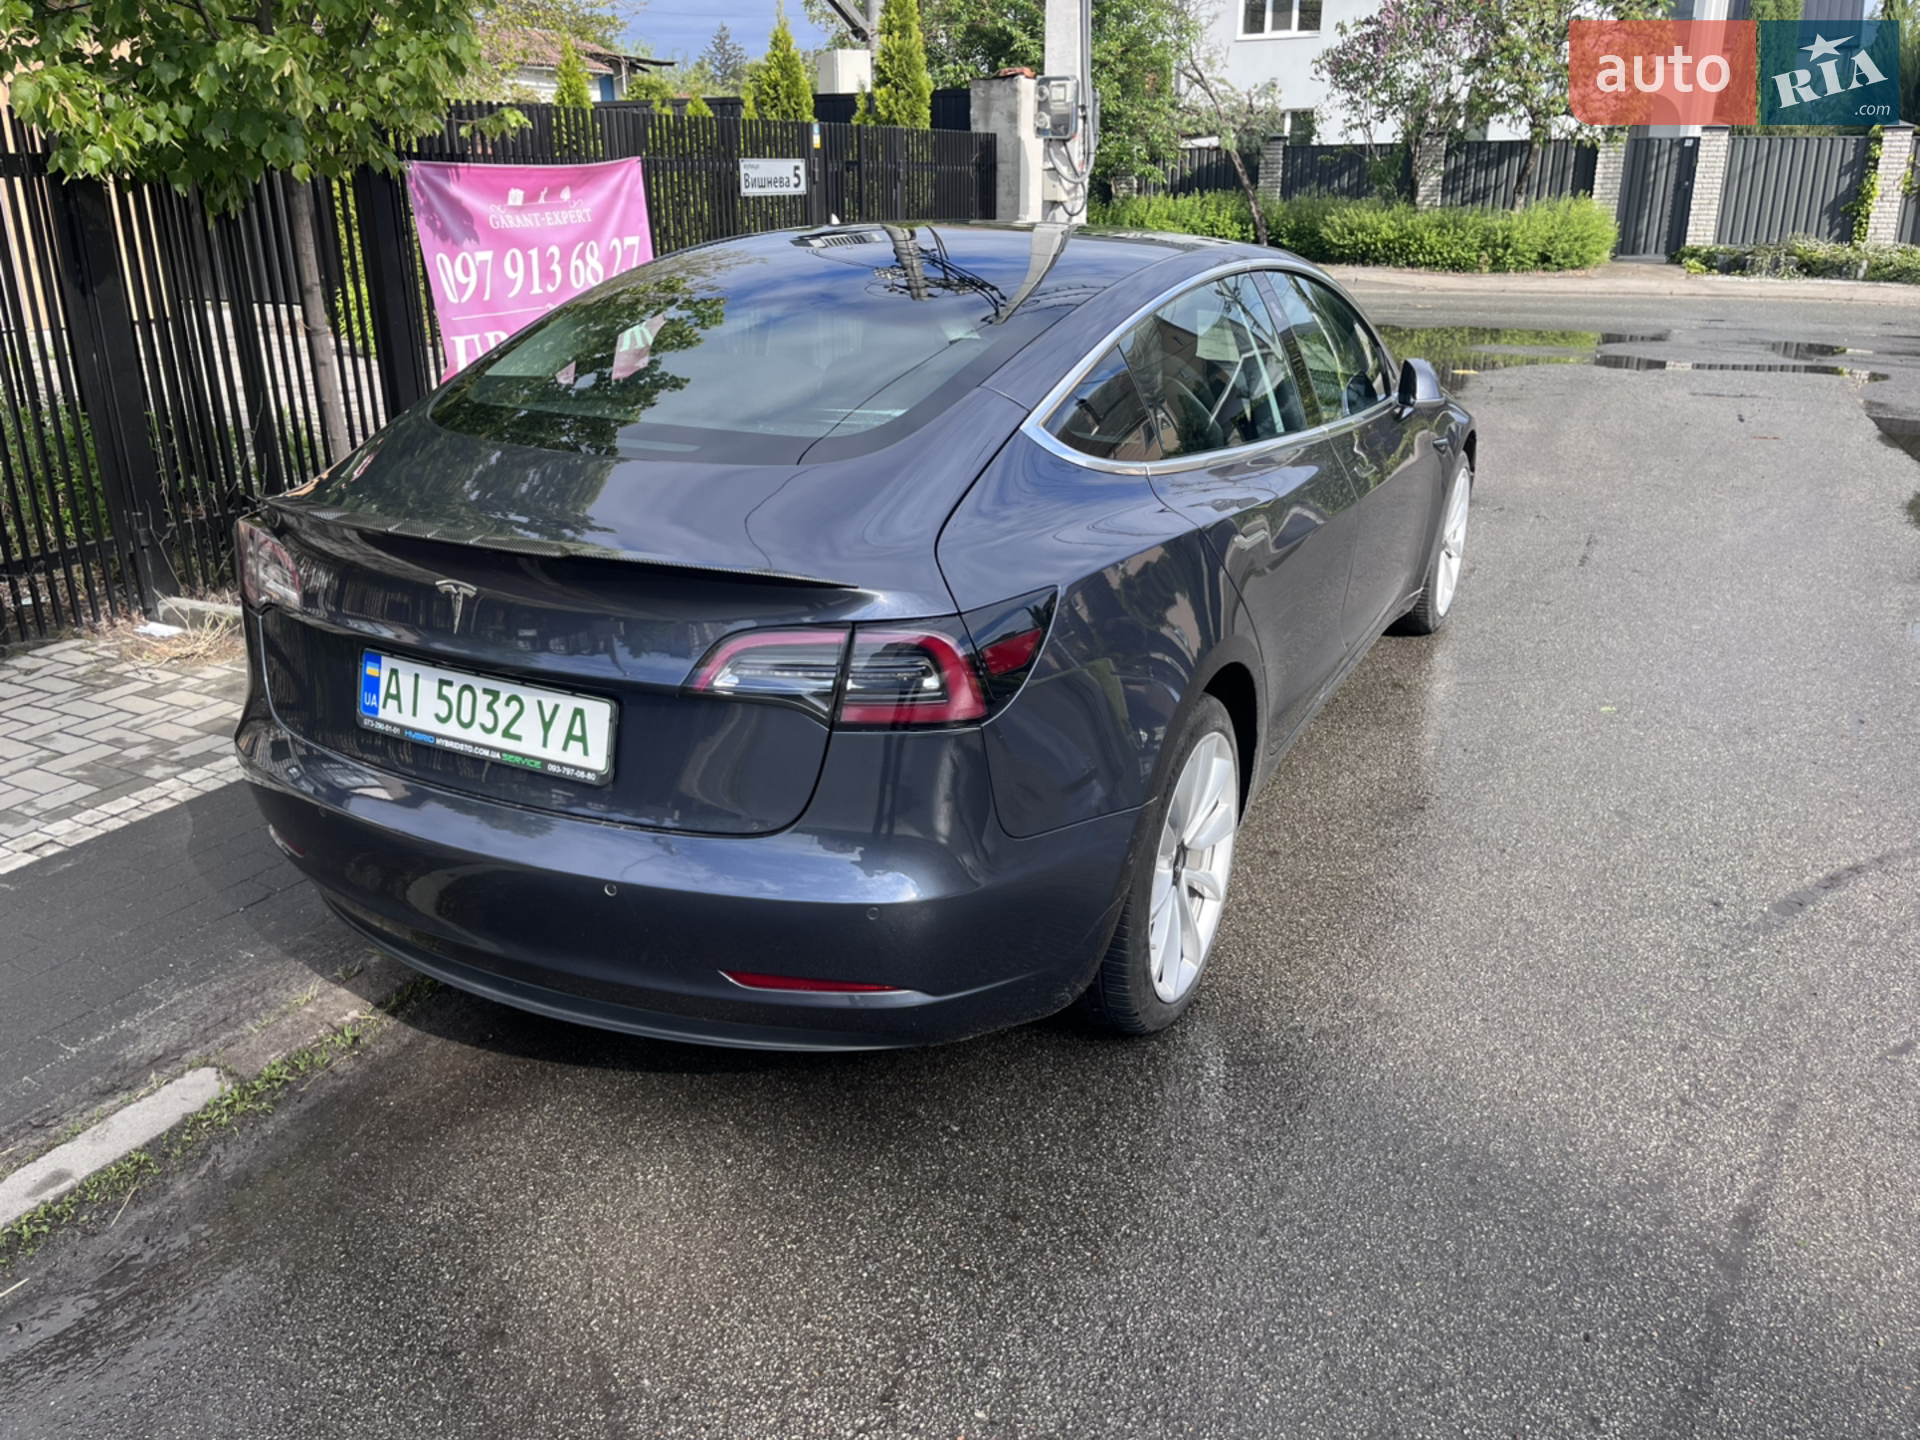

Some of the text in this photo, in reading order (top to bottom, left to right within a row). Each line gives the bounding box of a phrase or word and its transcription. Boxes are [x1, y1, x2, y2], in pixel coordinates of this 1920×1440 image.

[743, 165, 802, 189] Вишнева 5
[489, 208, 592, 229] GARANT-EXPERT
[436, 235, 640, 304] 097 913 68 27
[364, 691, 378, 708] UA
[382, 667, 590, 757] AI 5032 YA
[502, 752, 542, 768] SERVICE
